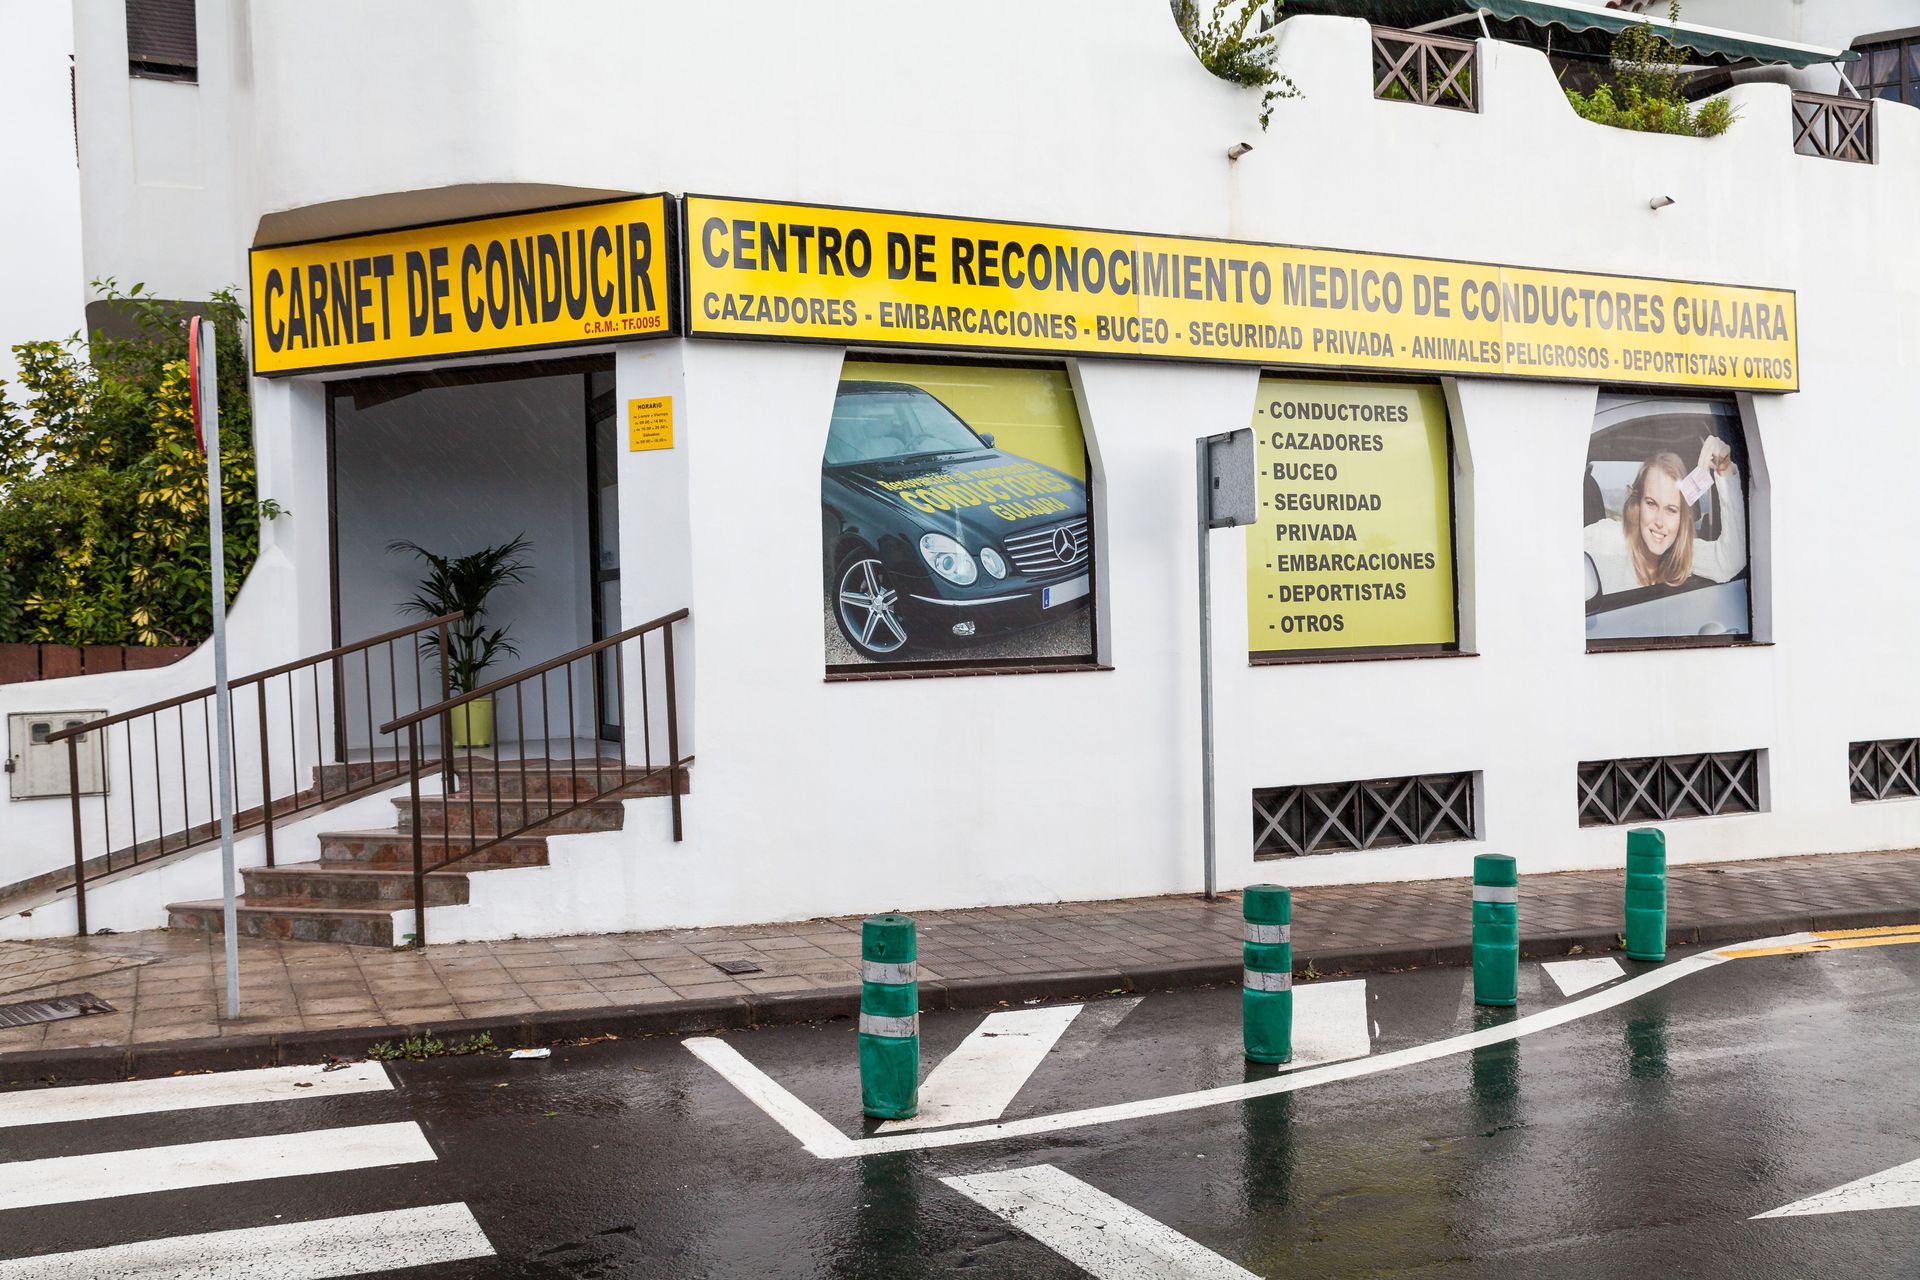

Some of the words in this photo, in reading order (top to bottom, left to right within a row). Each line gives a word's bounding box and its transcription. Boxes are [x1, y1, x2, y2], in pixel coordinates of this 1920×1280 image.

[264, 254, 395, 353] CARNET
[406, 246, 453, 337] DE
[460, 221, 657, 333] CONDUCIR
[701, 216, 872, 278] CENTRO
[886, 231, 937, 283] DE
[952, 237, 1272, 306] RECONOCIMIENTO
[1282, 262, 1403, 315] MEDICO
[1413, 274, 1450, 318] DE
[1461, 279, 1665, 334] CONDUCTORES
[1673, 296, 1789, 341] GUAJARA
[584, 319, 619, 334] C.R.M.:
[621, 315, 662, 331] TF.0095
[703, 291, 858, 327] CAZADORES
[879, 301, 1077, 340] EMBARCACIONES
[1096, 314, 1169, 345] BUCEO
[1189, 320, 1303, 350] SEGURIDAD
[1312, 328, 1395, 358] PRIVADA
[1411, 335, 1501, 364] ANIMALES
[1505, 342, 1610, 369] PELIGROSOS
[1622, 348, 1727, 376] DEPORTISTAS
[1728, 357, 1739, 377] Y
[1743, 356, 1792, 380] OTROS
[637, 402, 663, 410] HORARIO
[1270, 401, 1409, 422] CONDUCTORES
[1271, 432, 1384, 452] CAZADORES
[1273, 463, 1338, 481] BUCEO
[899, 470, 1073, 513] CONDUCTORES
[989, 496, 1070, 521] GUAJARA
[1274, 493, 1382, 511] SEGURIDAD
[1276, 524, 1357, 541] PRIVADA
[1278, 552, 1436, 572] EMBARCACIONES
[1279, 582, 1407, 602] DEPORTISTAS
[1281, 614, 1344, 633] OTROS
